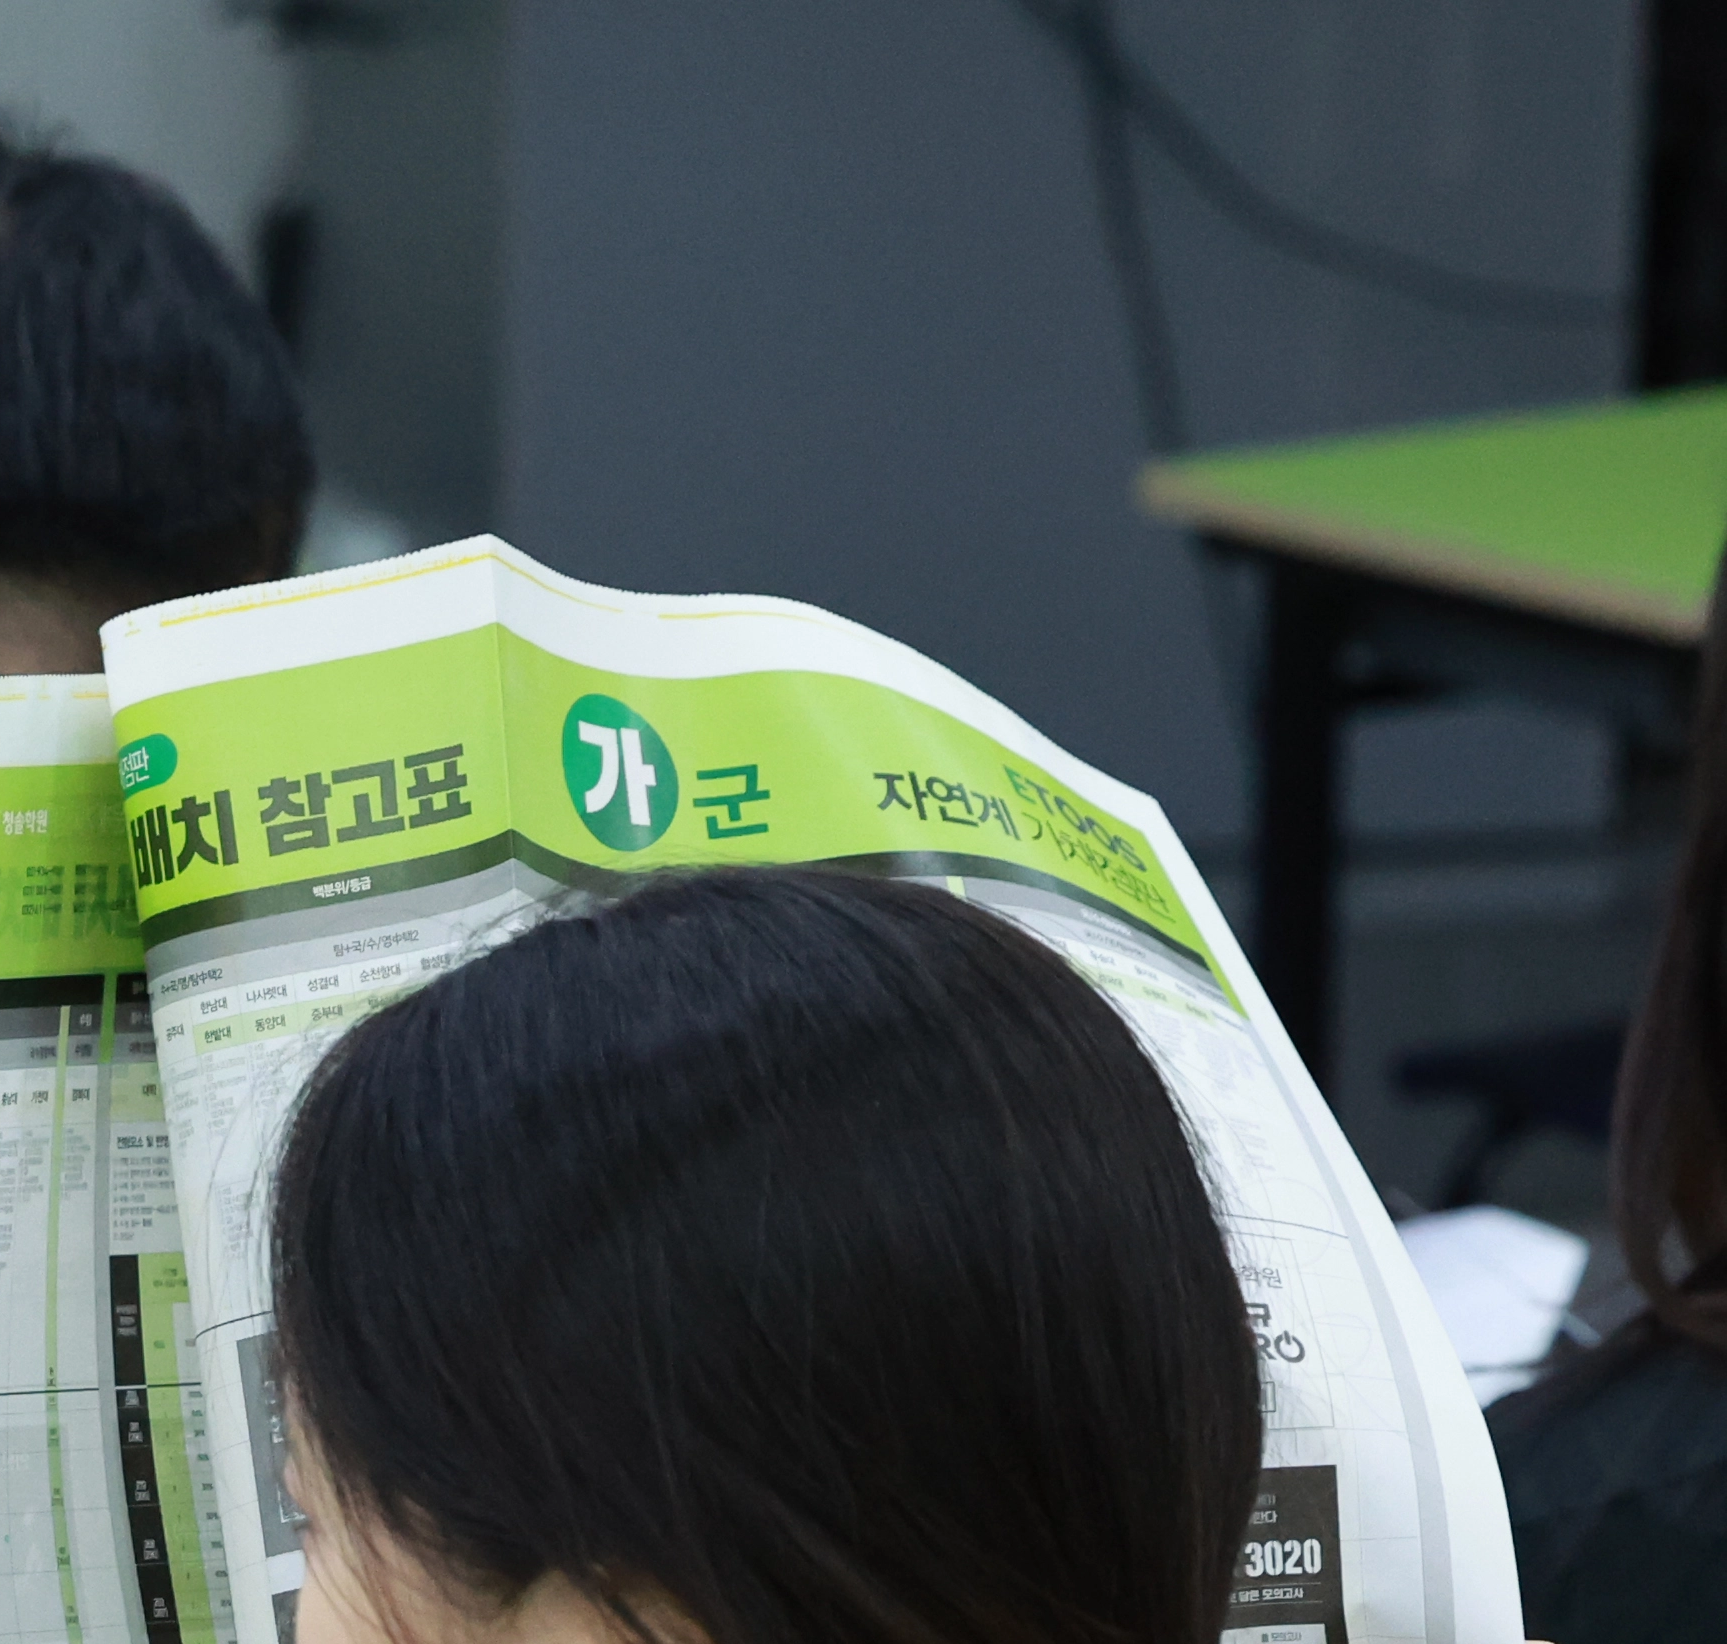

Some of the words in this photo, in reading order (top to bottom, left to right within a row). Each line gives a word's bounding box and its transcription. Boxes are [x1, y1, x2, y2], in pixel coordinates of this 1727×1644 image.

[122, 746, 149, 787] 점판
[577, 720, 657, 827] 가
[692, 764, 771, 840] 군
[2, 809, 48, 836] 청솔학원
[130, 789, 240, 889] 배치
[257, 743, 472, 857] 참고표
[872, 770, 1022, 843] 자연계
[1003, 764, 1147, 873] ETOOS
[312, 875, 372, 900] 백분위/등급
[246, 984, 288, 1003] 나사렛대
[307, 975, 340, 992] 성결대
[1262, 1587, 1305, 1601] 모의고사
